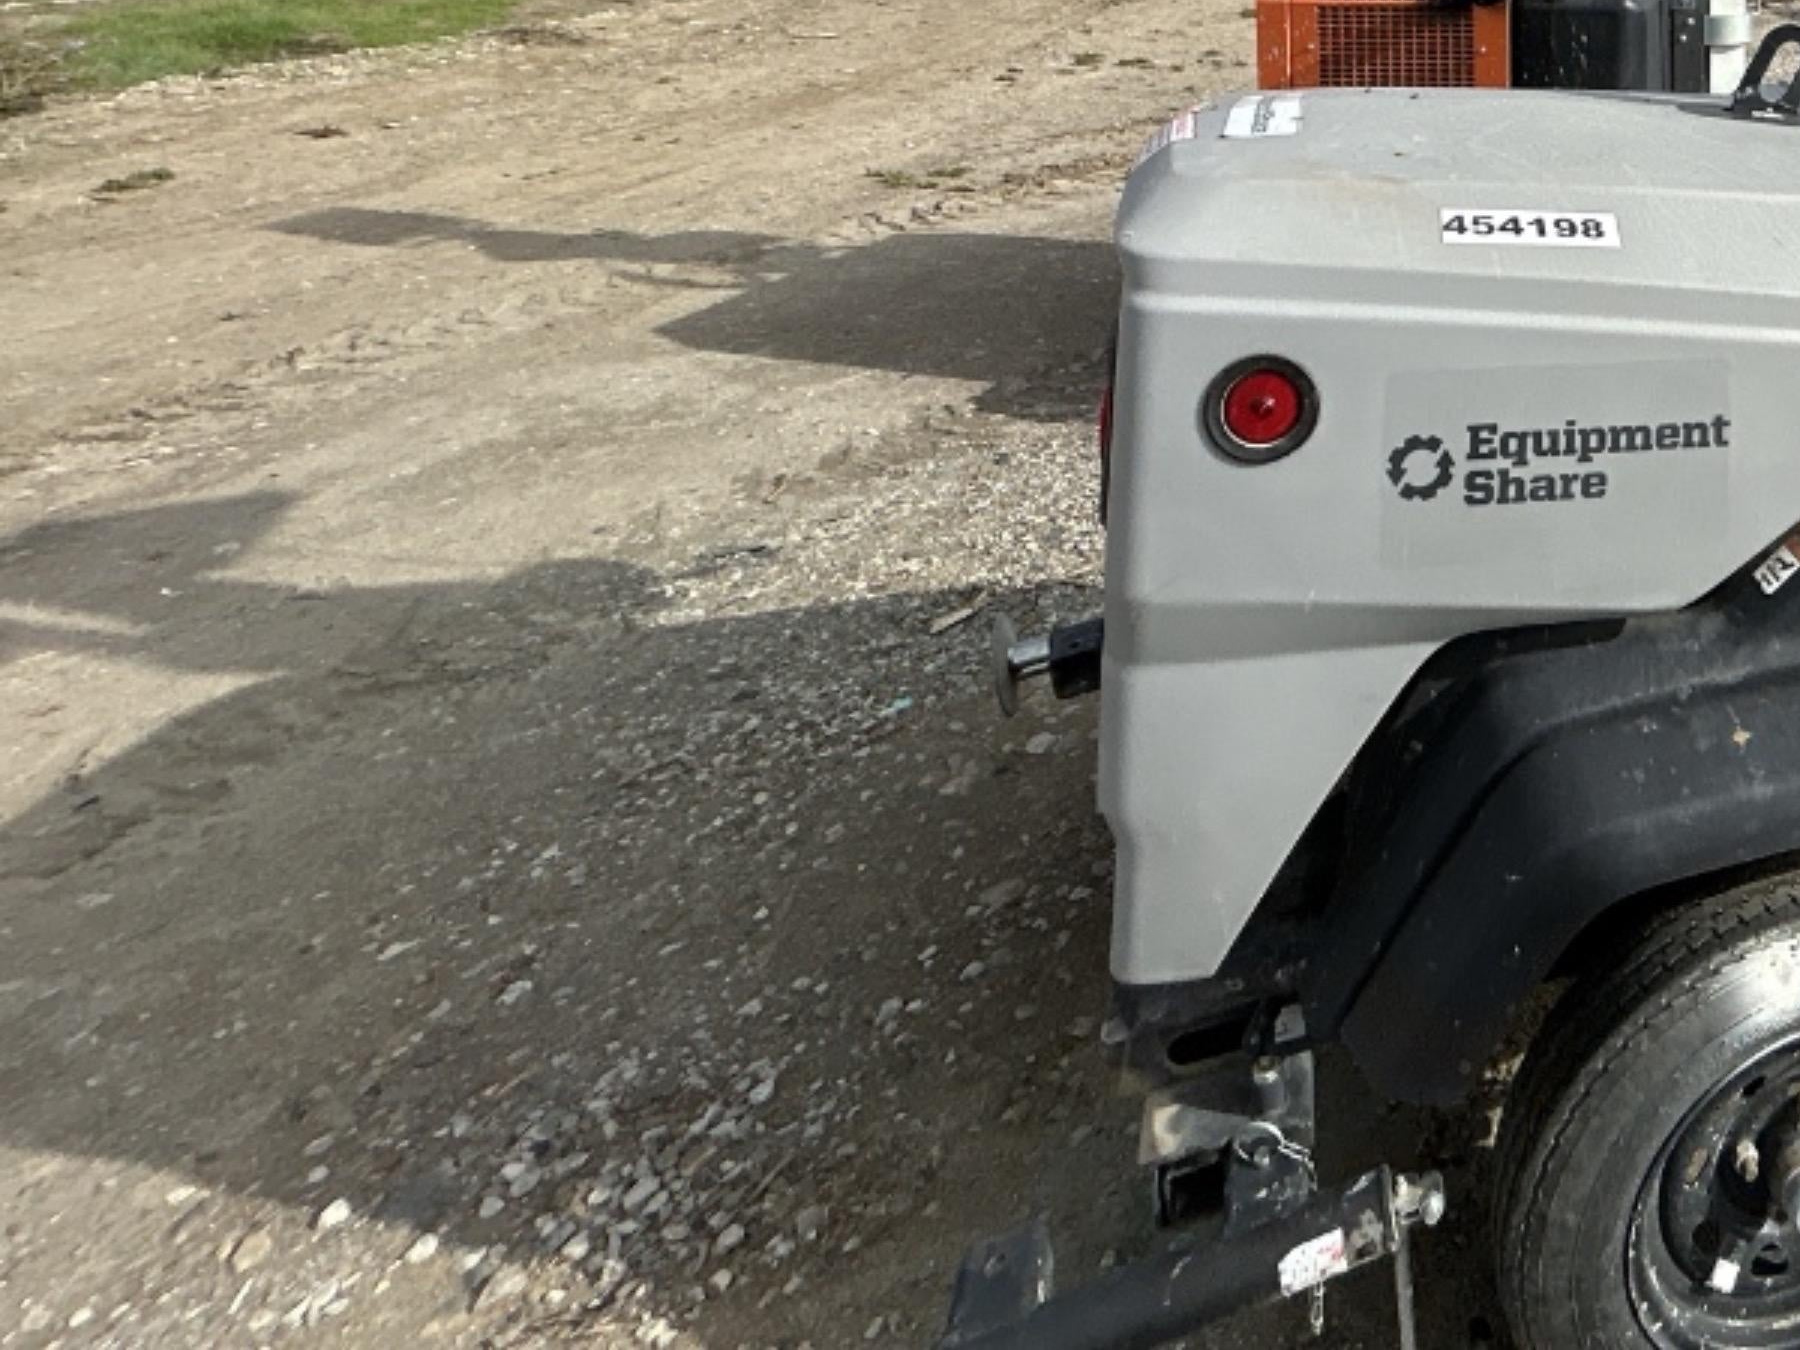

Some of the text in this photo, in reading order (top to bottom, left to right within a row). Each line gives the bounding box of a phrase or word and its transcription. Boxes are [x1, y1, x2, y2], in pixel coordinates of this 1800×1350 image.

[1442, 214, 1606, 240] 454198
[1466, 413, 1731, 467] Equipment
[1463, 468, 1608, 507] Share
